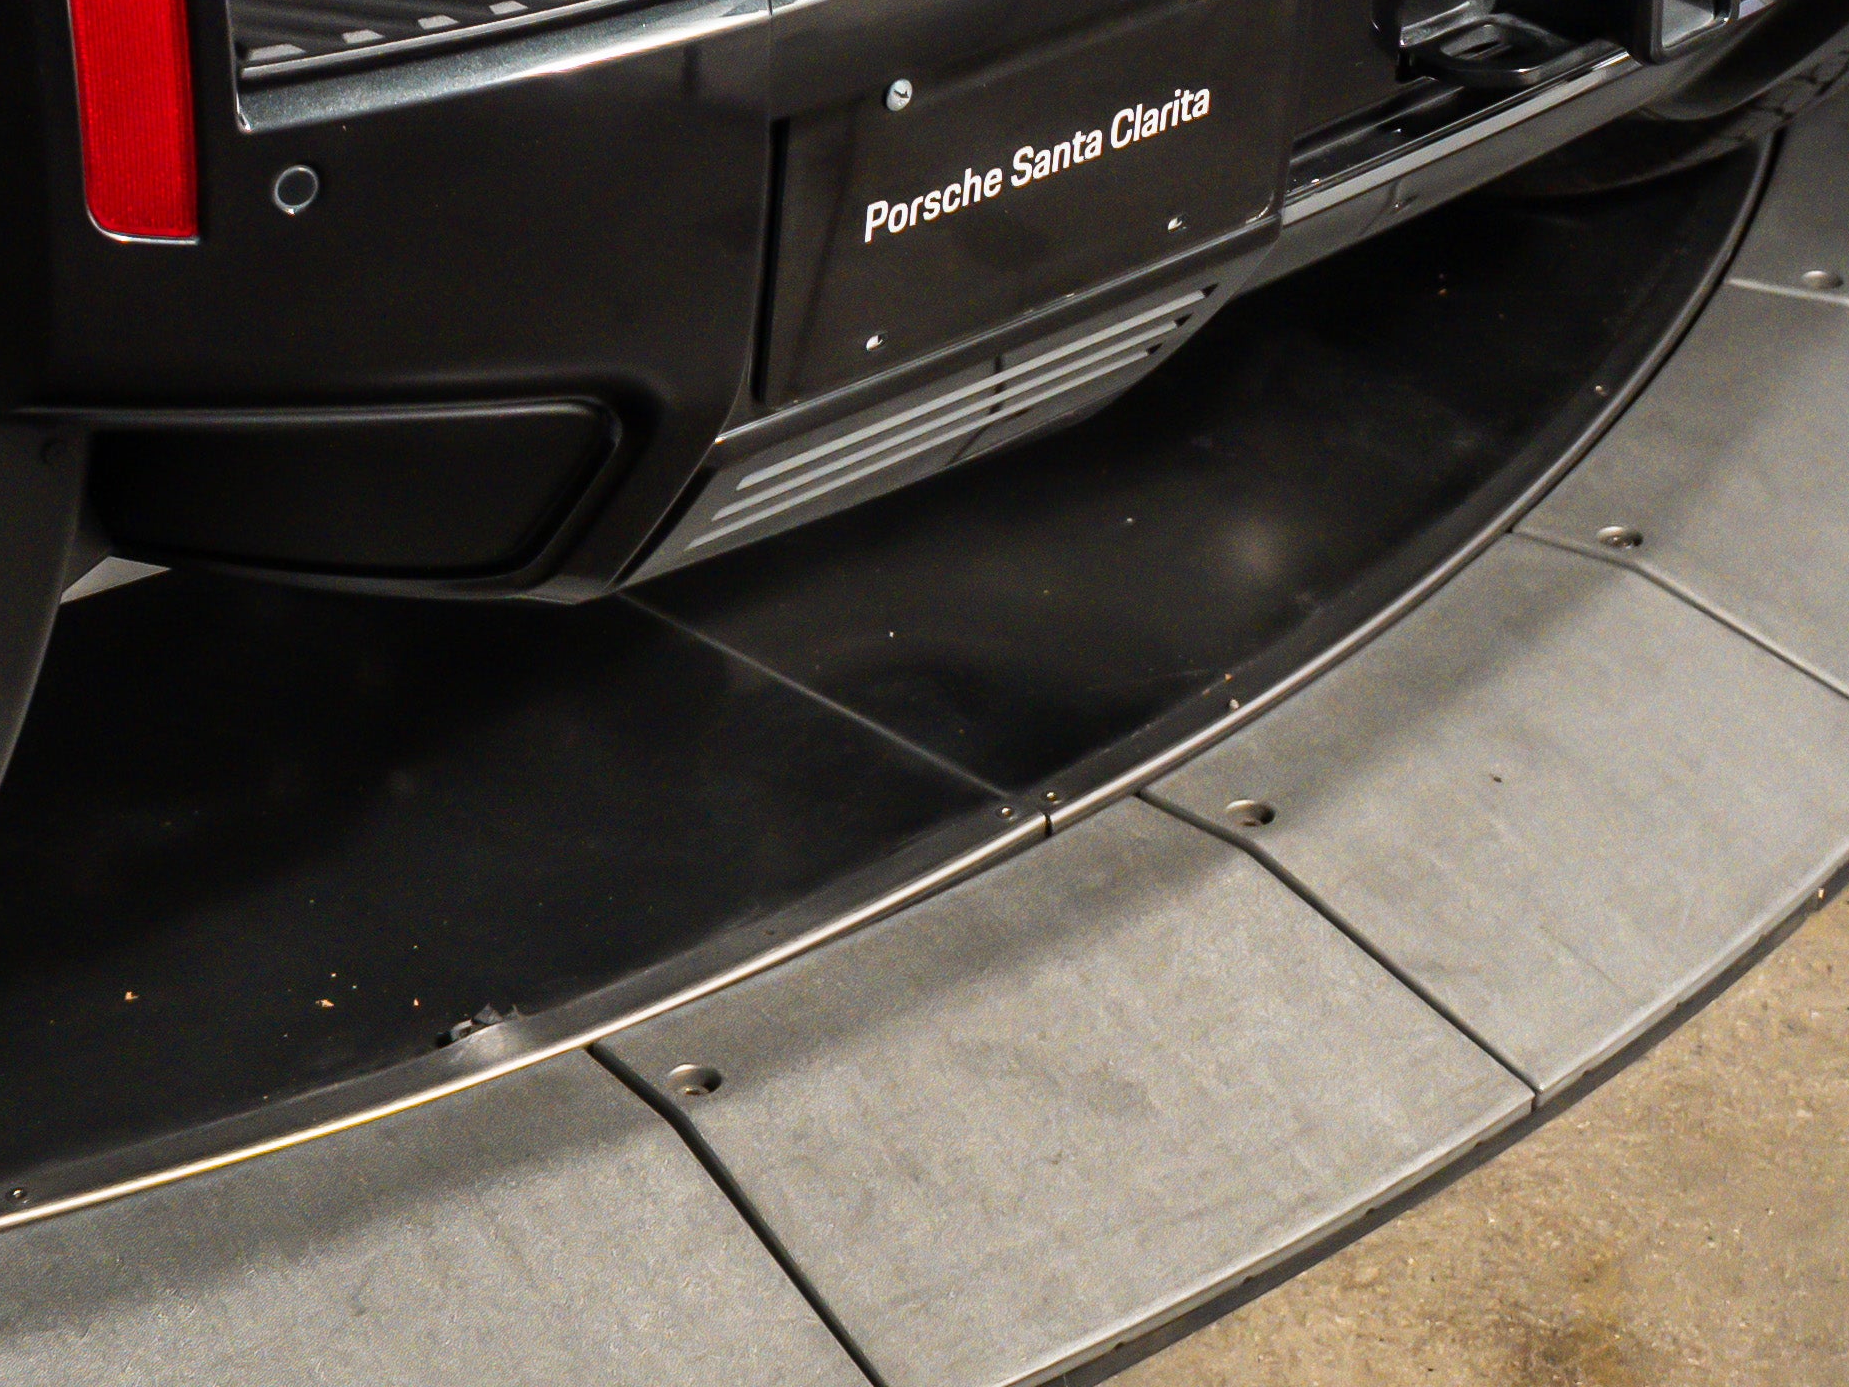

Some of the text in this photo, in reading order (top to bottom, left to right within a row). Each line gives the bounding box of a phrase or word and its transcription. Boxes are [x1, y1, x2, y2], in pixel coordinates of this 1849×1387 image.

[864, 88, 1210, 243] Porsche Santa Clarita
